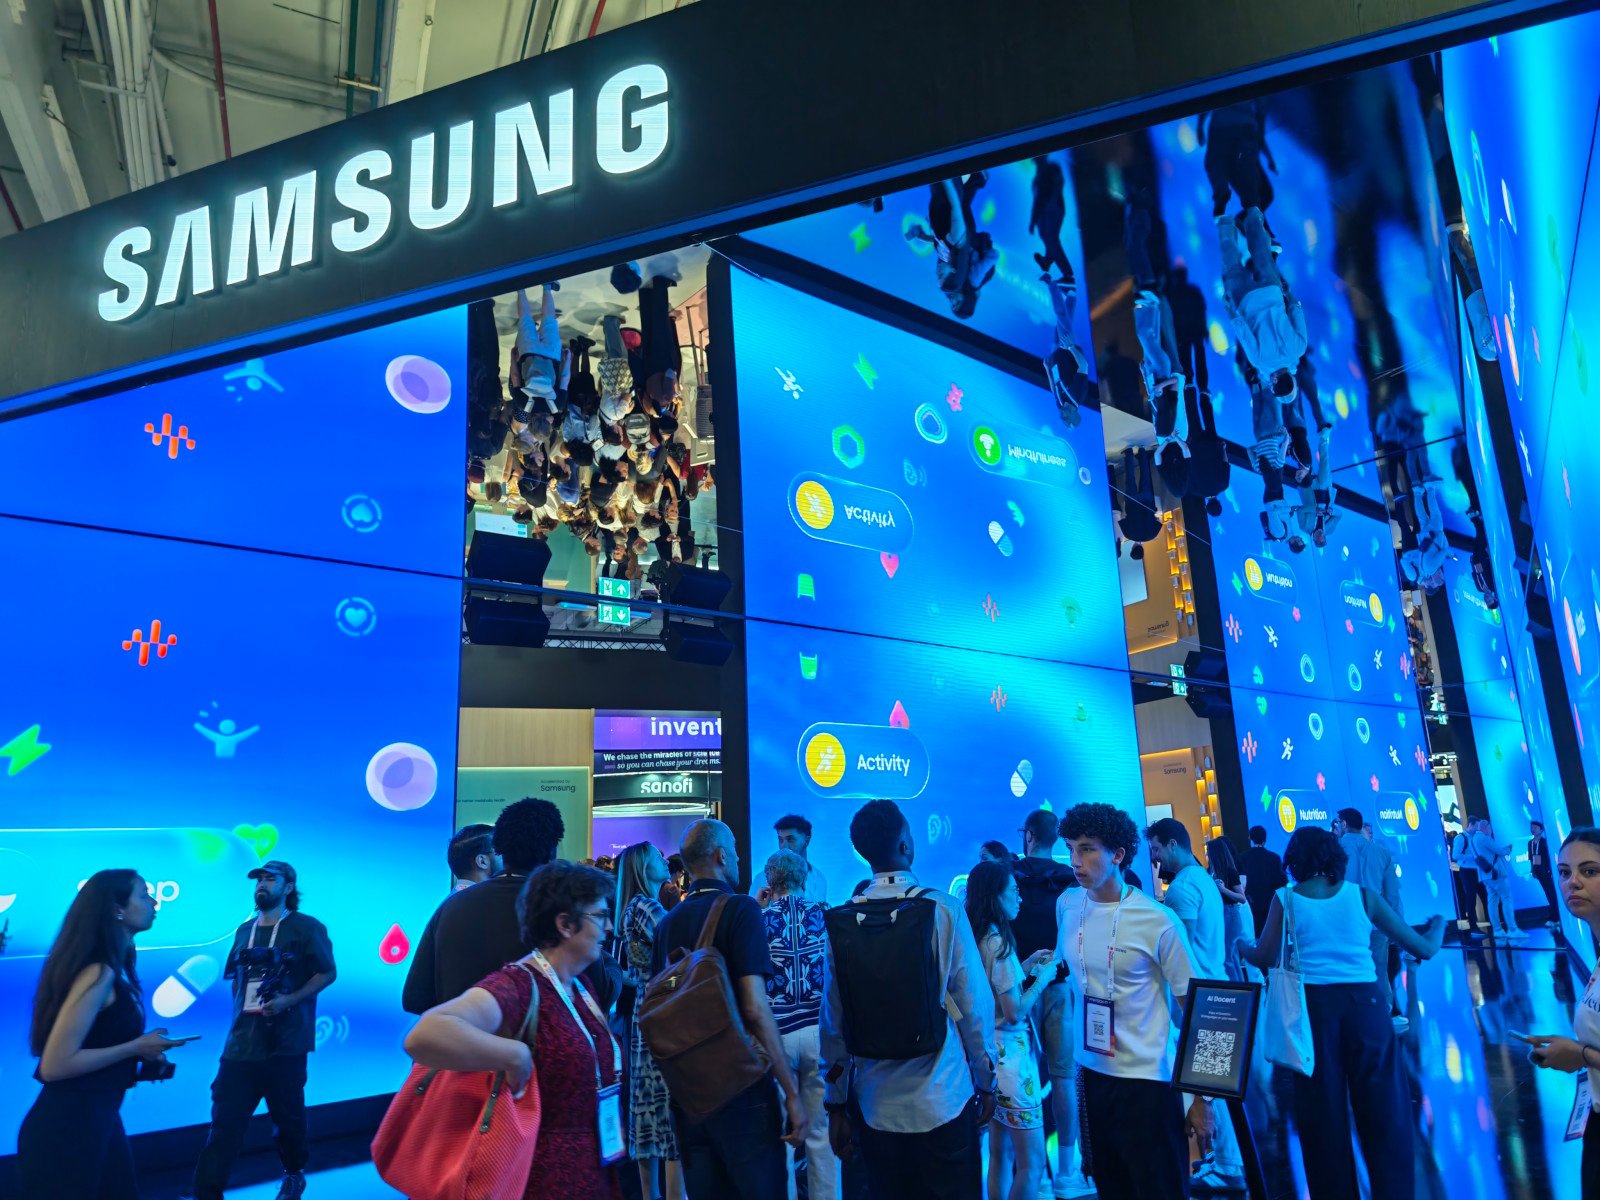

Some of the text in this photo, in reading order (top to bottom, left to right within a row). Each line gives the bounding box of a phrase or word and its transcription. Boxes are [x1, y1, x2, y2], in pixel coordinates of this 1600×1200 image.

[98, 63, 670, 322] SAMSUNG
[603, 753, 616, 761] We
[639, 752, 653, 760] the
[653, 751, 684, 759] miracles
[675, 760, 693, 769] your
[857, 754, 911, 777] Activity
[540, 784, 576, 793] Samsung
[640, 777, 693, 794] sanofi
[1299, 808, 1328, 821] Nutrition
